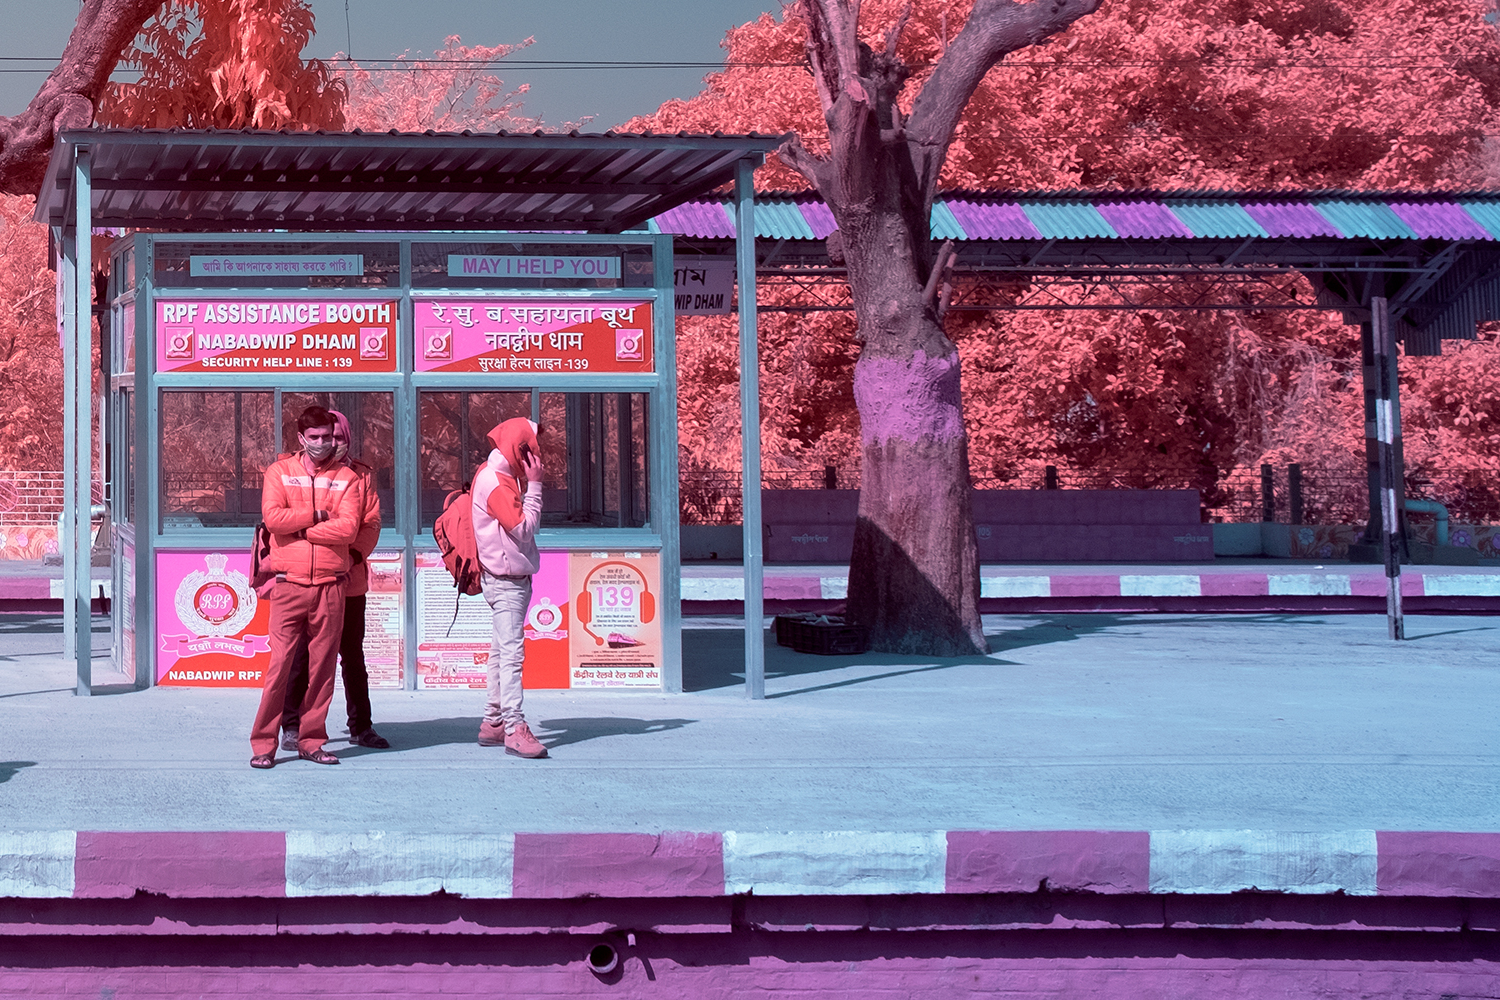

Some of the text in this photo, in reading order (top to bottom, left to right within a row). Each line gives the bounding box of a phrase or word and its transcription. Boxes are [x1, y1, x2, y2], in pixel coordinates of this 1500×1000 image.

[203, 259, 221, 273] আমি
[223, 259, 234, 273] কি
[236, 260, 272, 273] আপনাকে
[303, 260, 327, 272] করতে
[463, 258, 609, 276] MAY I HELP YOU
[694, 293, 724, 310] DHAM
[163, 303, 390, 324] RPF ASSISTANCE BOOTH
[599, 306, 636, 328] बूथ
[198, 333, 356, 350] NABADWIP DHAM
[484, 327, 583, 351] नवद्वीप धाम
[201, 357, 260, 368] SECURITY
[263, 357, 293, 368] HELP
[296, 357, 323, 368] LINE
[332, 357, 353, 368] 139
[478, 357, 507, 372] सुरक्षा
[510, 355, 531, 371] हेल्प
[534, 356, 562, 370] लाइन
[596, 586, 634, 606] 139
[169, 670, 262, 681] NABADWIP RPF
